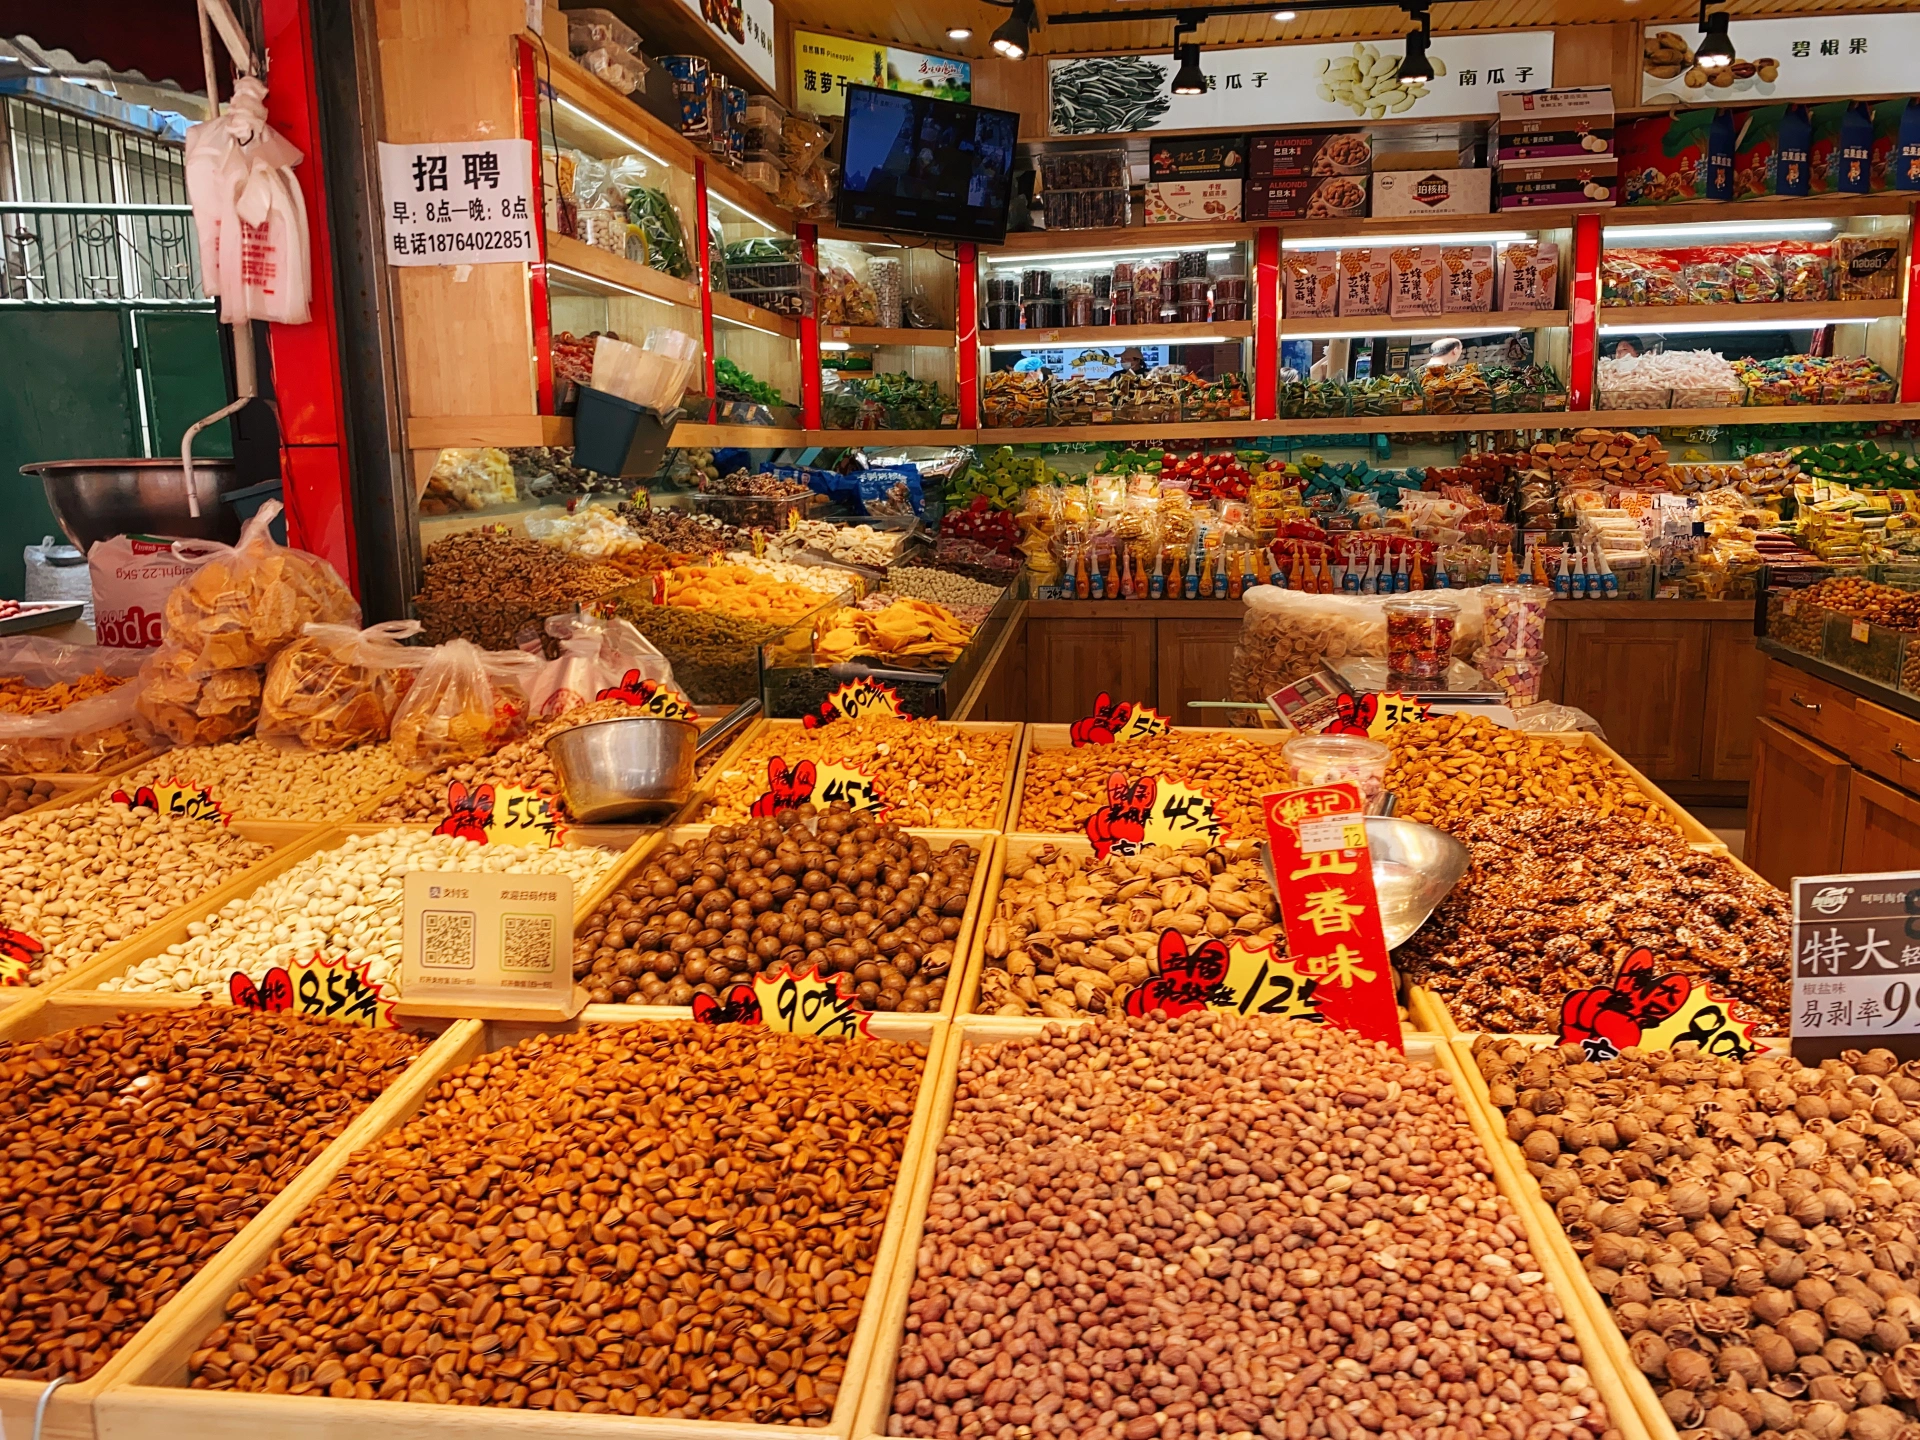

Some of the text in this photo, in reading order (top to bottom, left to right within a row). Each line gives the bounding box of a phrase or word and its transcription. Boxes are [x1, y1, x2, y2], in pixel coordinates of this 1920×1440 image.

[1791, 37, 1868, 58] 碧根果
[826, 50, 855, 63] Pineapple
[803, 68, 848, 98] 菠萝干
[1458, 67, 1534, 87] 南瓜子
[1274, 139, 1313, 147] ALMONDS
[1273, 147, 1296, 156] 巴旦木
[411, 151, 501, 192] 招聘
[1269, 181, 1308, 189] ALMONDS
[1268, 190, 1291, 198] 巴旦木
[393, 230, 532, 256] 电话18764022851
[116, 566, 198, 581] eight:22.5Kg
[1343, 833, 1363, 847] 12
[1800, 927, 1900, 975] 特大
[1802, 982, 1847, 996] 椒盐味
[1799, 998, 1883, 1029] 易剥率
